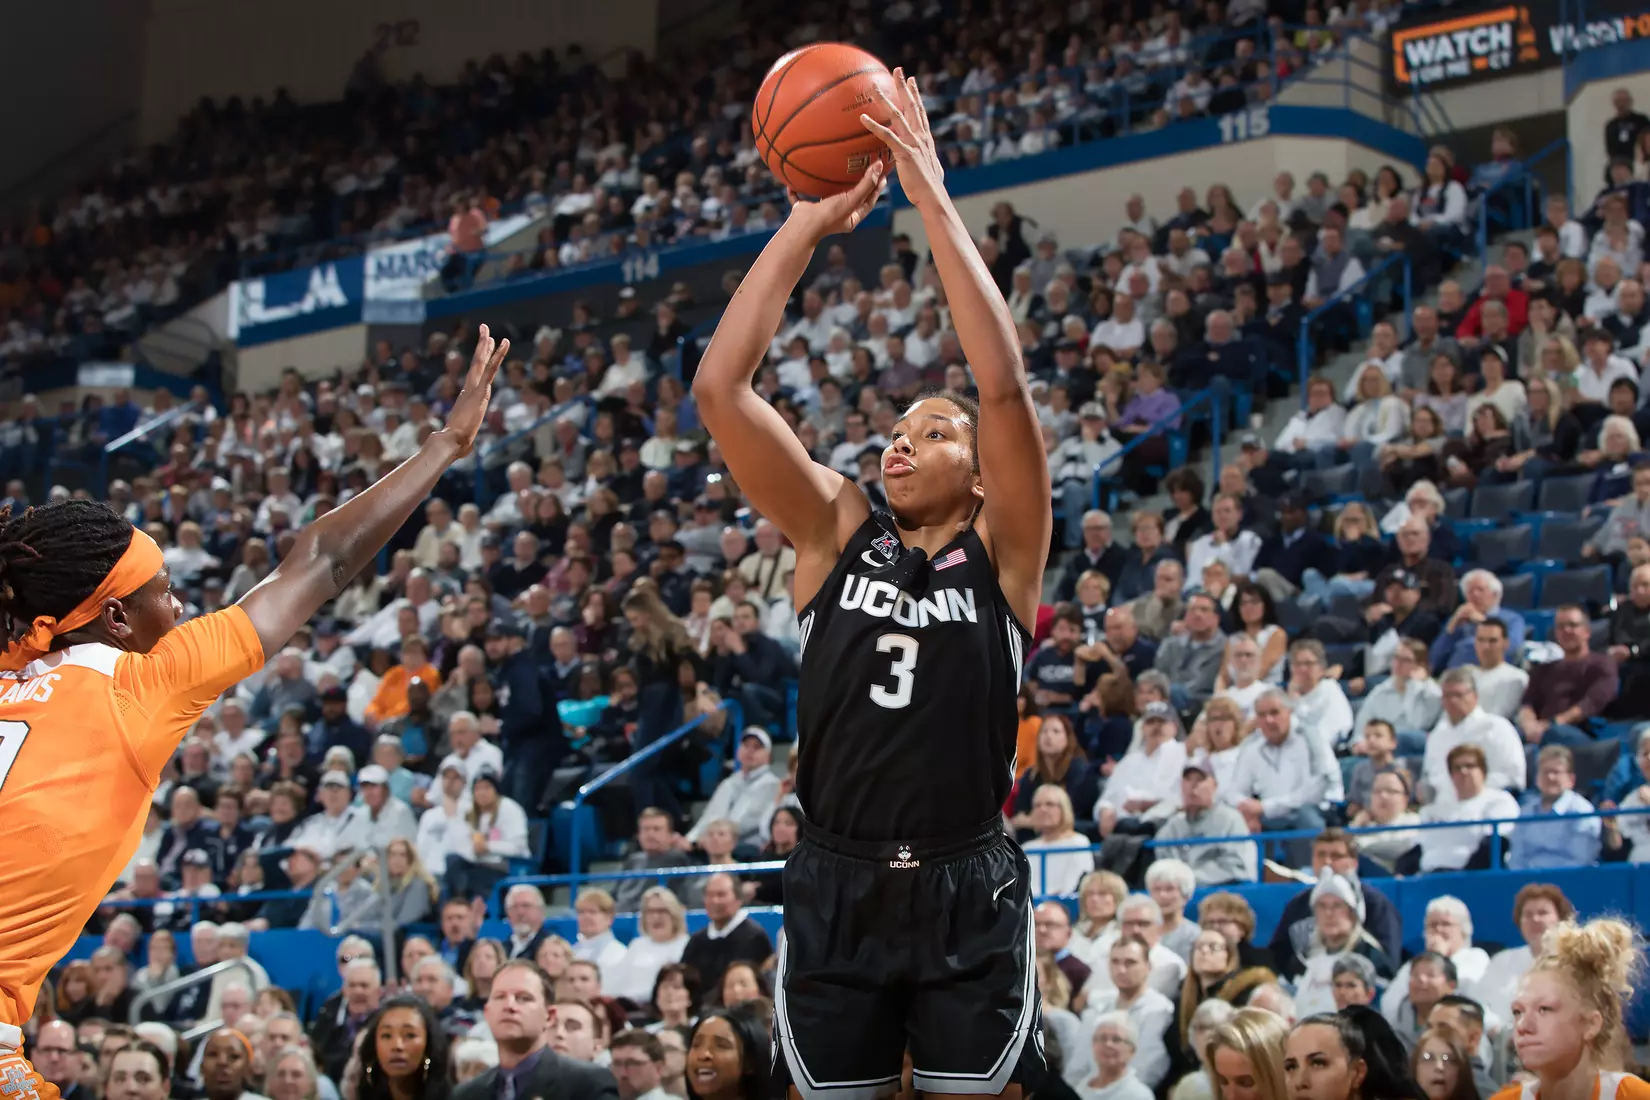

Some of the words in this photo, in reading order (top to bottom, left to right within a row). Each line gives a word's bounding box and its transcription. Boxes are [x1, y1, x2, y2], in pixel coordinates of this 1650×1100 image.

[1404, 22, 1512, 67] WATCH
[1218, 107, 1270, 142] 115
[621, 252, 660, 284] 114
[839, 574, 978, 629] UCONN
[869, 633, 920, 709] 3
[889, 860, 920, 869] UCONN
